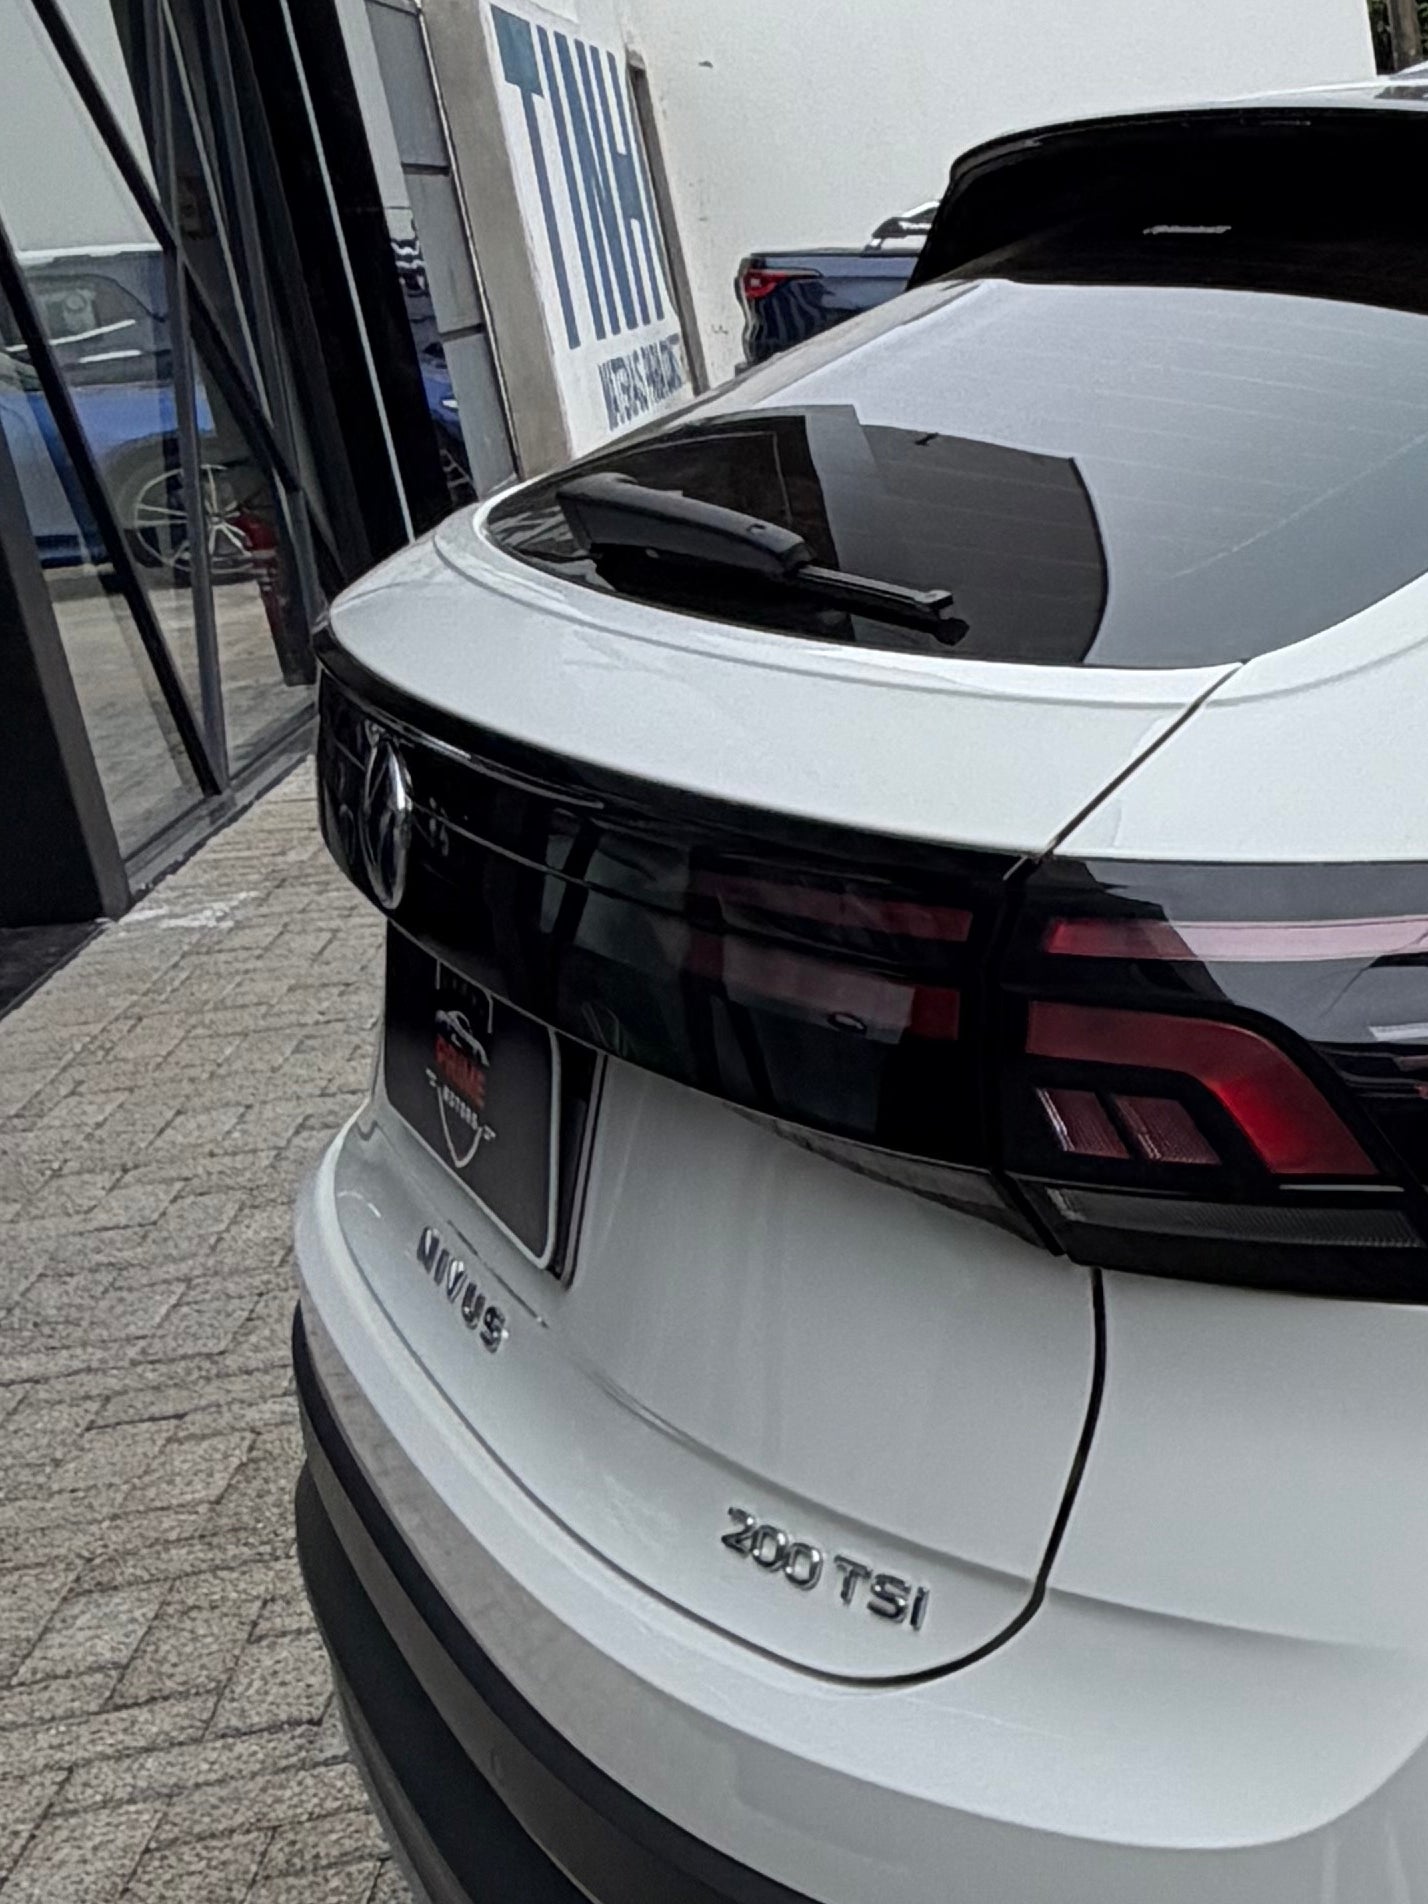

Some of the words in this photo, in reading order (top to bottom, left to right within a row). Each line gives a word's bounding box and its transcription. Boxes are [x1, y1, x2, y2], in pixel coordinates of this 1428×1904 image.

[416, 1225, 507, 1354] NIVUS
[721, 1506, 824, 1592] 200
[833, 1554, 930, 1632] TSI
